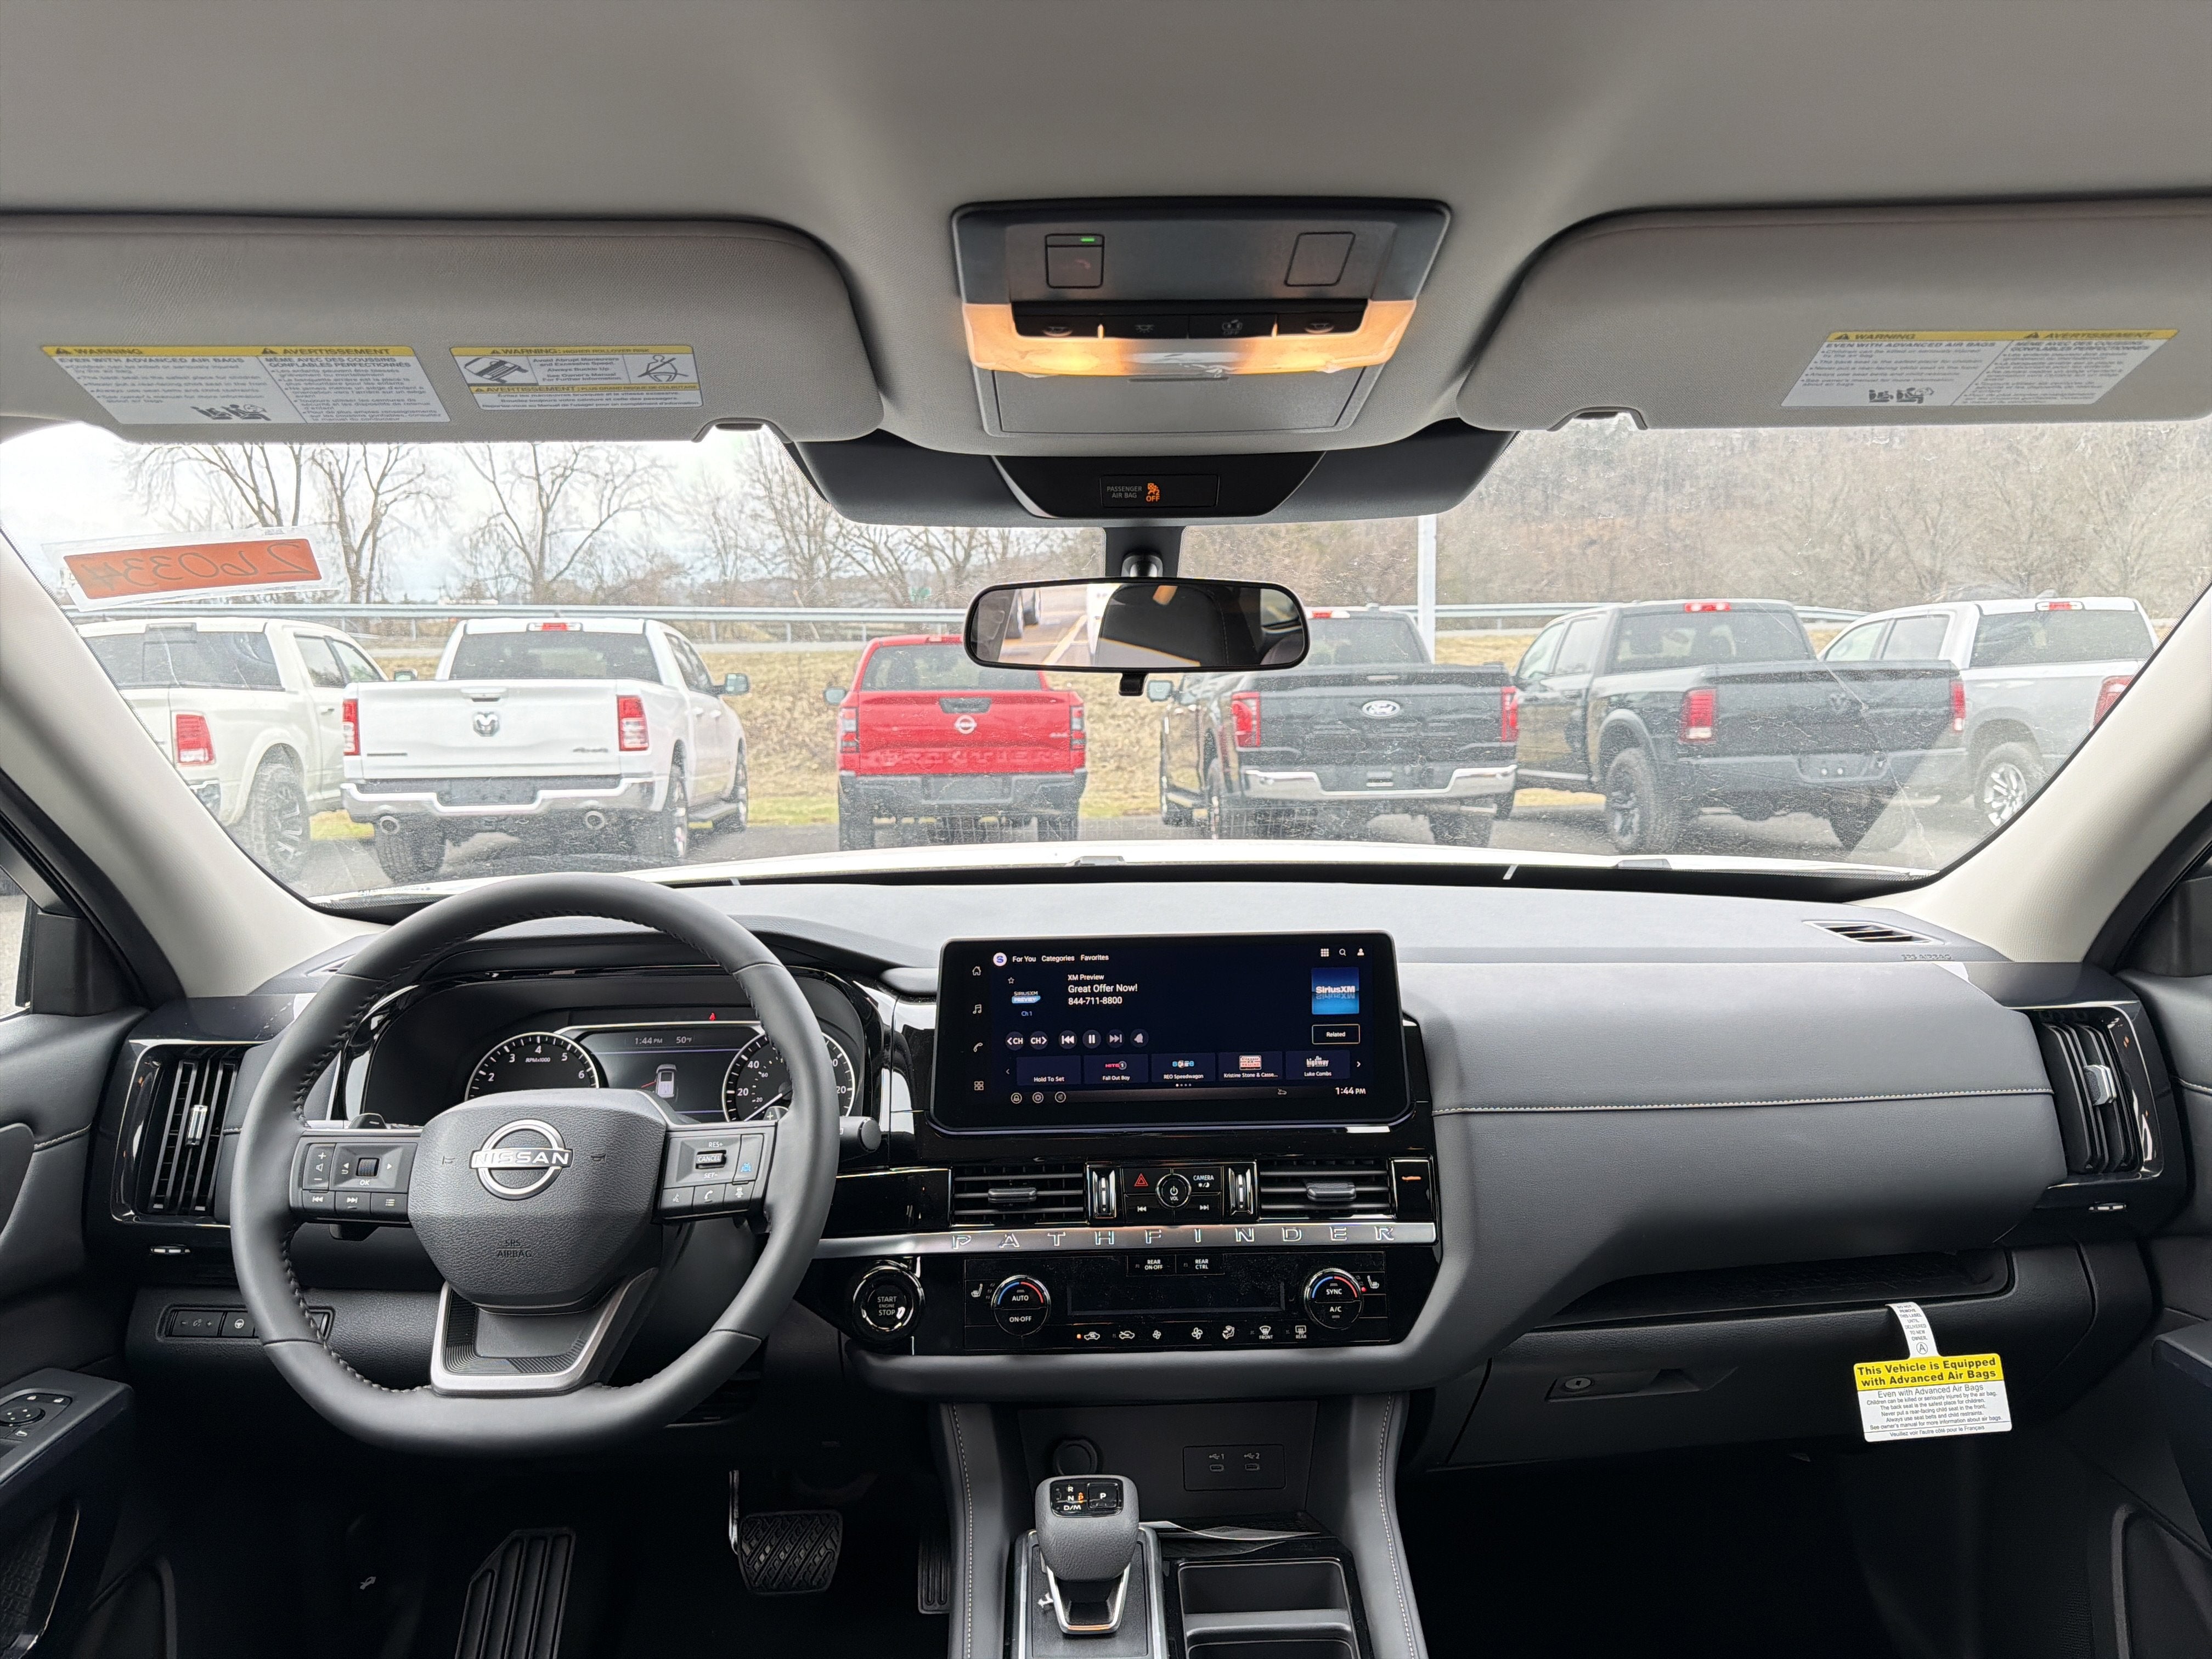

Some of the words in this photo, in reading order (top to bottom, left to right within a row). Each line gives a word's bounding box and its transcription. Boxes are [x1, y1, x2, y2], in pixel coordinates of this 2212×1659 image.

[1041, 955, 1075, 963] Categories
[1068, 984, 1091, 994] Great
[1093, 984, 1114, 992] Offer
[1116, 984, 1138, 992] Now!
[1316, 985, 1355, 994] SiriusXM
[1068, 996, 1122, 1005] 844-711-8800
[535, 1045, 541, 1054] 4
[509, 1053, 516, 1063] 3
[561, 1052, 568, 1062] 5
[747, 1060, 760, 1069] 40
[1306, 1058, 1329, 1067] highway
[488, 1073, 495, 1082] 2
[578, 1070, 585, 1079] 6
[737, 1088, 749, 1096] 20
[1335, 1087, 1354, 1095] 1:44
[475, 1151, 569, 1165] NISSAN
[951, 1226, 1395, 1250] PATHFINDER
[505, 1239, 521, 1247] SRS
[1919, 1344, 1926, 1352] A
[1857, 1365, 1882, 1376] This
[1884, 1362, 1926, 1374] Vehicle
[1929, 1361, 1940, 1370] is
[1943, 1357, 1996, 1371] Equipped
[1861, 1376, 1886, 1387] with
[1889, 1372, 1944, 1385] Advanced
[1948, 1370, 1963, 1380] Air
[1967, 1369, 1996, 1380] Bags
[1915, 1386, 1950, 1396] Advanced
[1965, 1384, 1984, 1392] Bags
